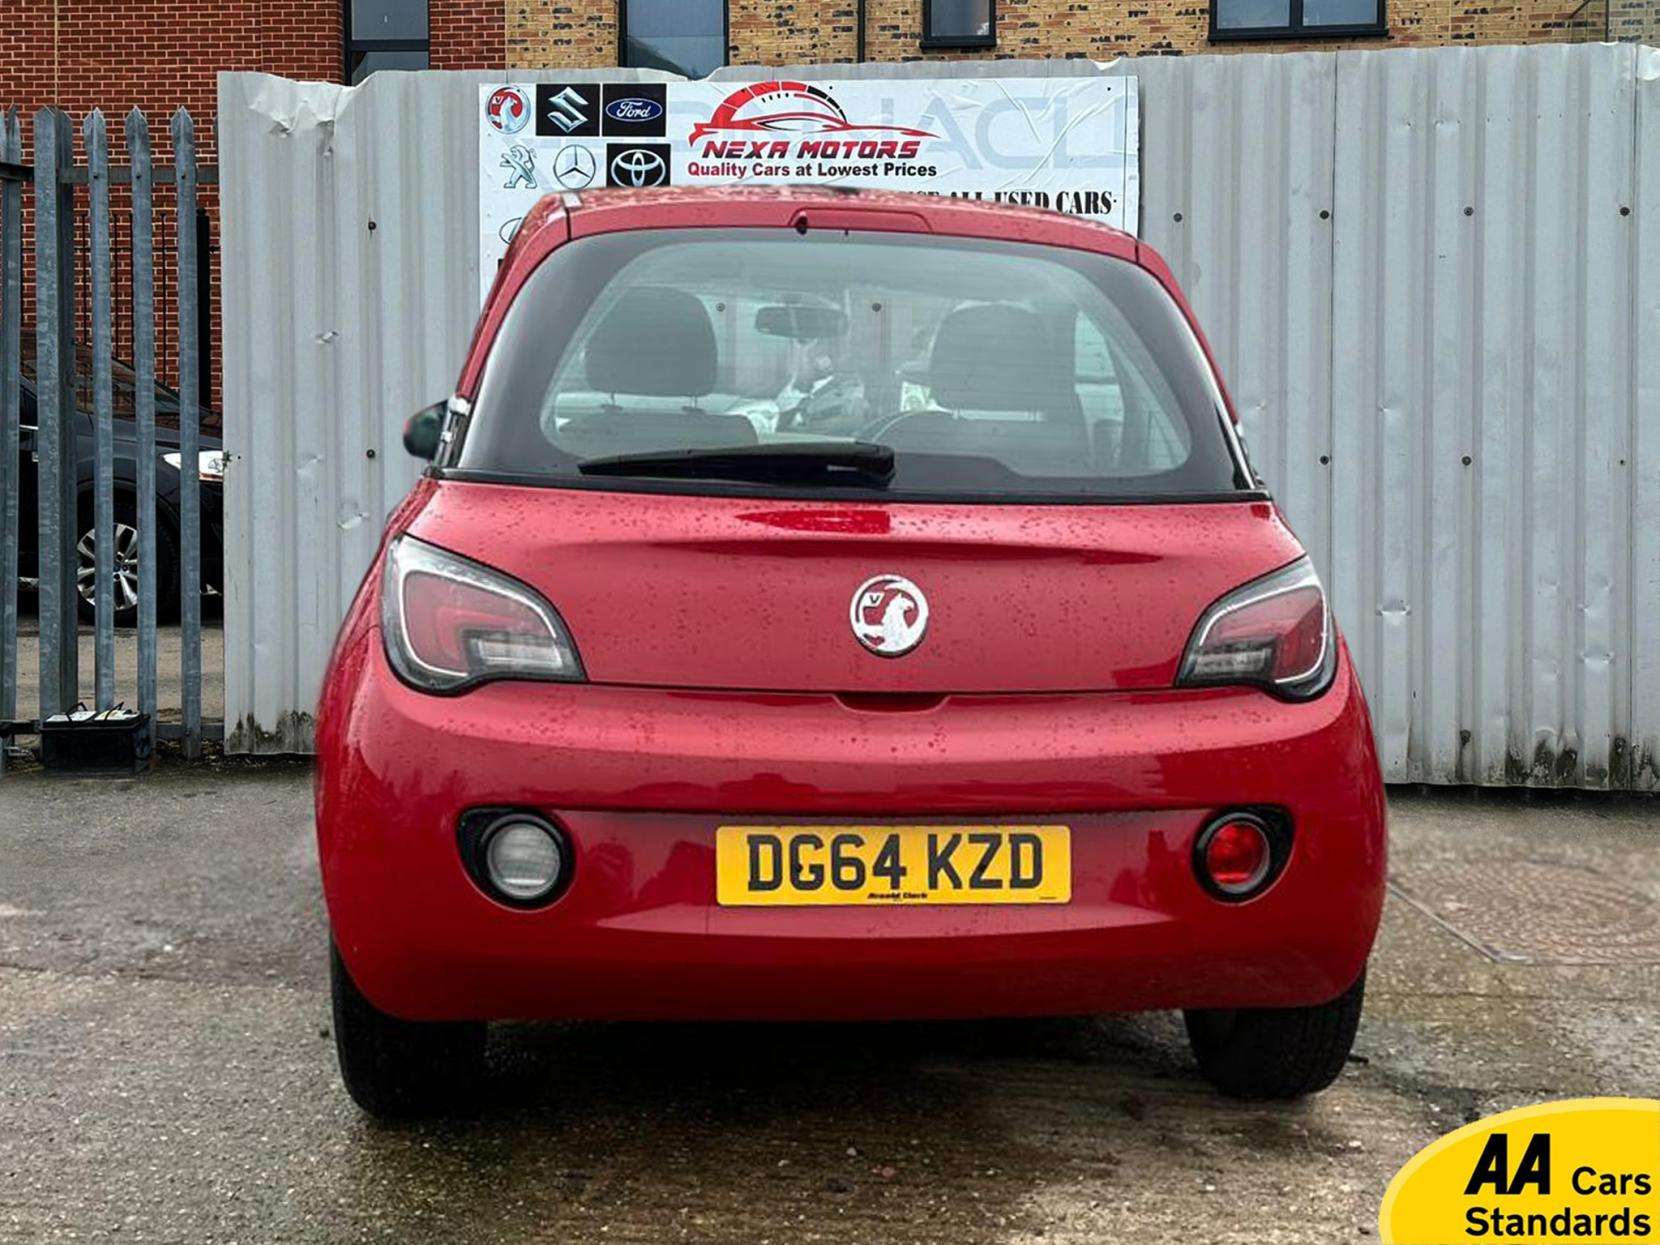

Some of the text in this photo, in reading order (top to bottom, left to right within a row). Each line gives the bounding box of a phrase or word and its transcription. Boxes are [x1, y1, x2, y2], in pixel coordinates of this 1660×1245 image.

[616, 101, 651, 118] Ford
[702, 141, 921, 159] NEXA MOTORS
[687, 162, 937, 178] Quality Cars at Lowest Prices
[1056, 191, 1112, 214] CARS
[747, 833, 1043, 891] DG64 KZD
